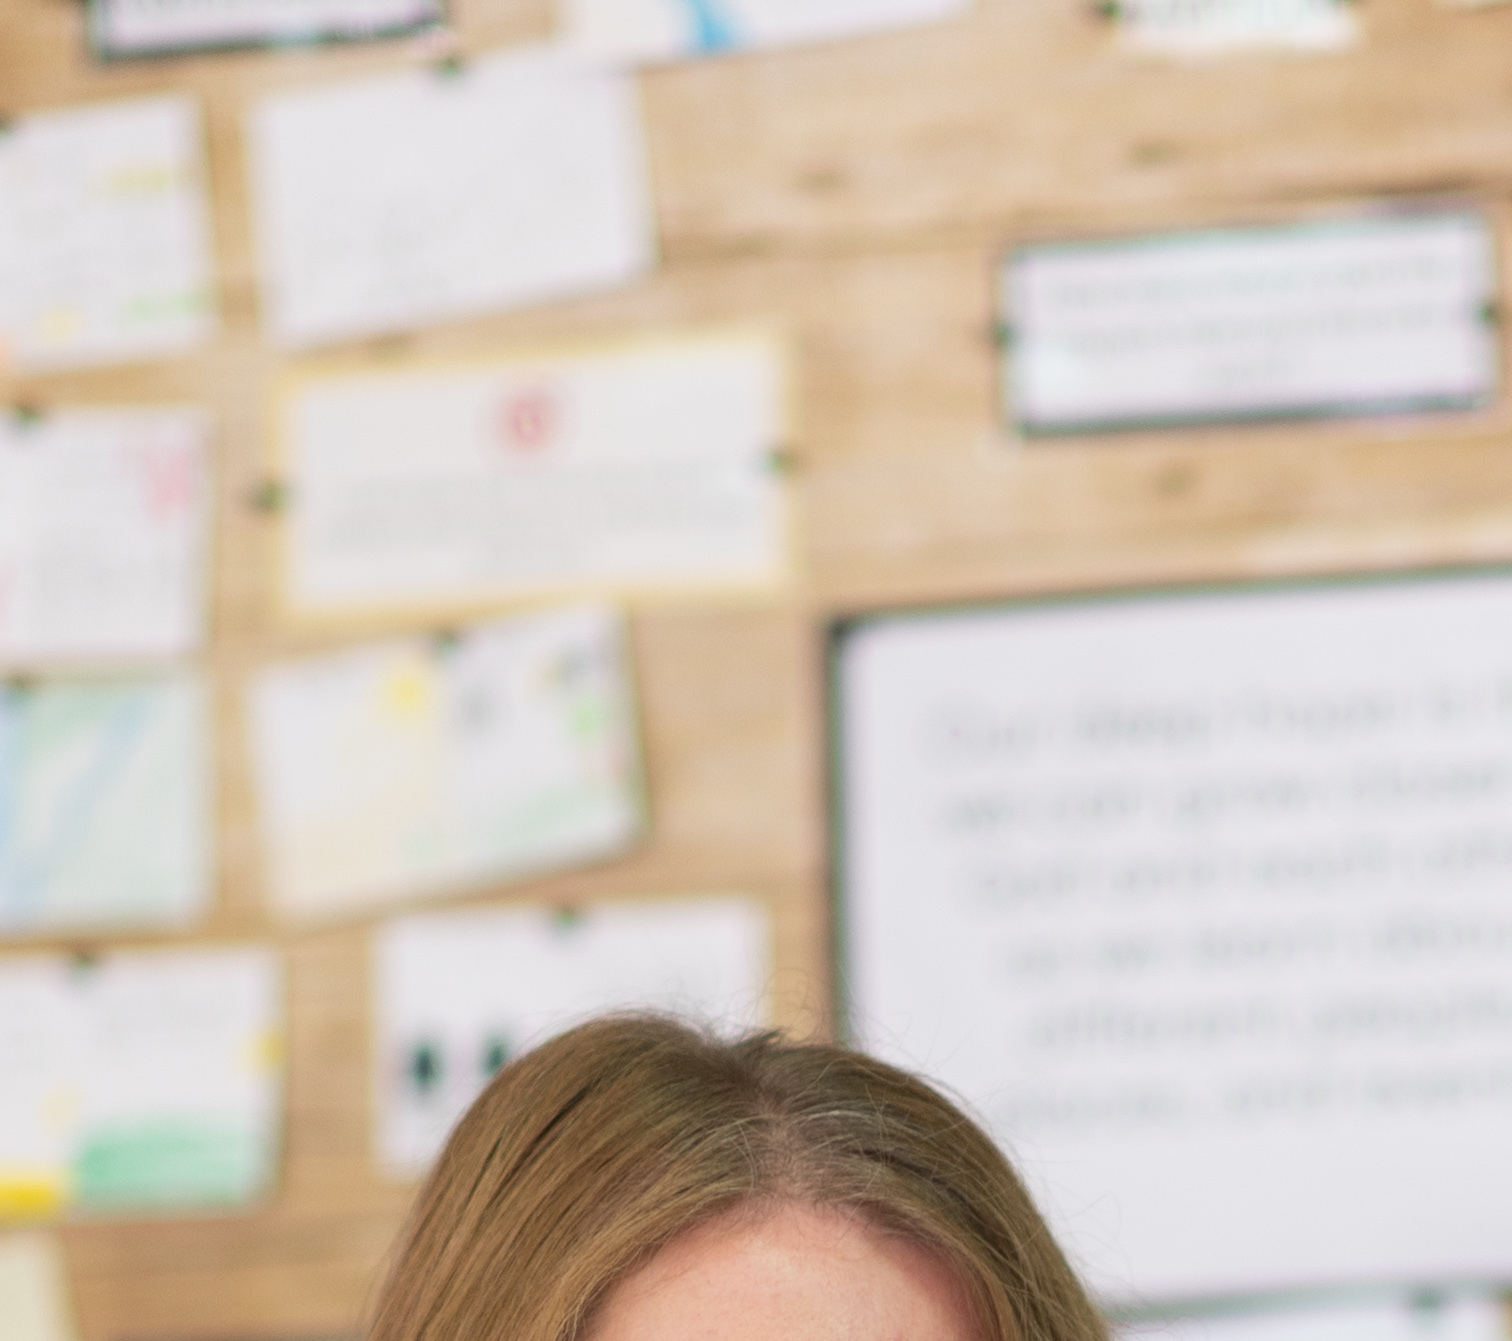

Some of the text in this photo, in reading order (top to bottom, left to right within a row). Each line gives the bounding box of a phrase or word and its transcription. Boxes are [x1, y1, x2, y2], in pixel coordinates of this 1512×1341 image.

[1064, 700, 1222, 760] deep
[1235, 686, 1401, 748] hope
[1032, 780, 1147, 834] can
[1168, 768, 1317, 830] grow
[960, 850, 1088, 911] God
[1104, 844, 1227, 900] and
[1242, 834, 1401, 894] each
[1184, 911, 1348, 970] learn
